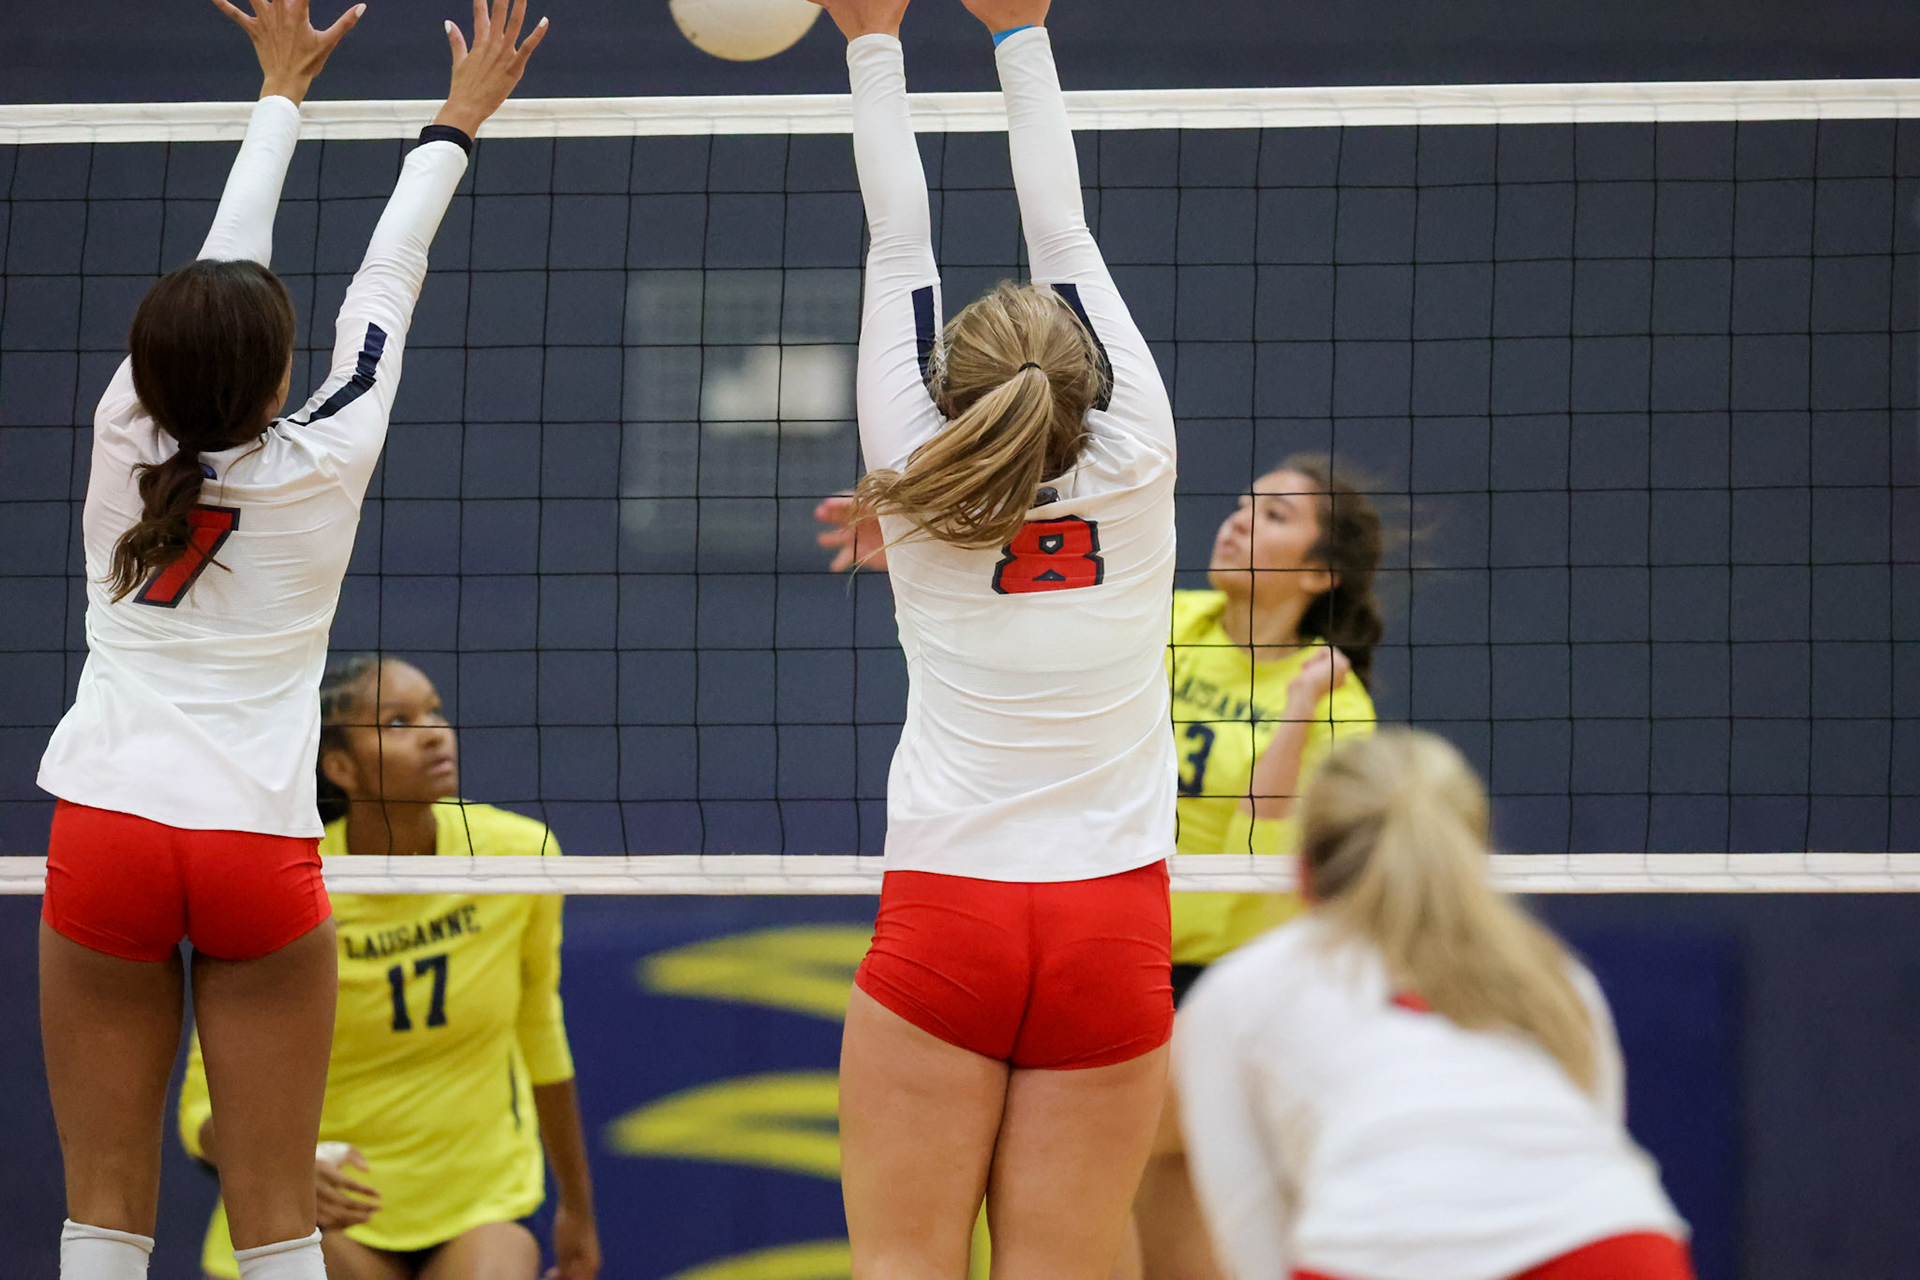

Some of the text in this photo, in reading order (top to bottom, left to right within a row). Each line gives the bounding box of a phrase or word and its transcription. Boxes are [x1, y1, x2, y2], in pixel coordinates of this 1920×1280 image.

[133, 504, 240, 609] 7
[991, 514, 1105, 595] 8
[344, 904, 482, 959] LAUSANNE
[388, 953, 449, 1032] 17
